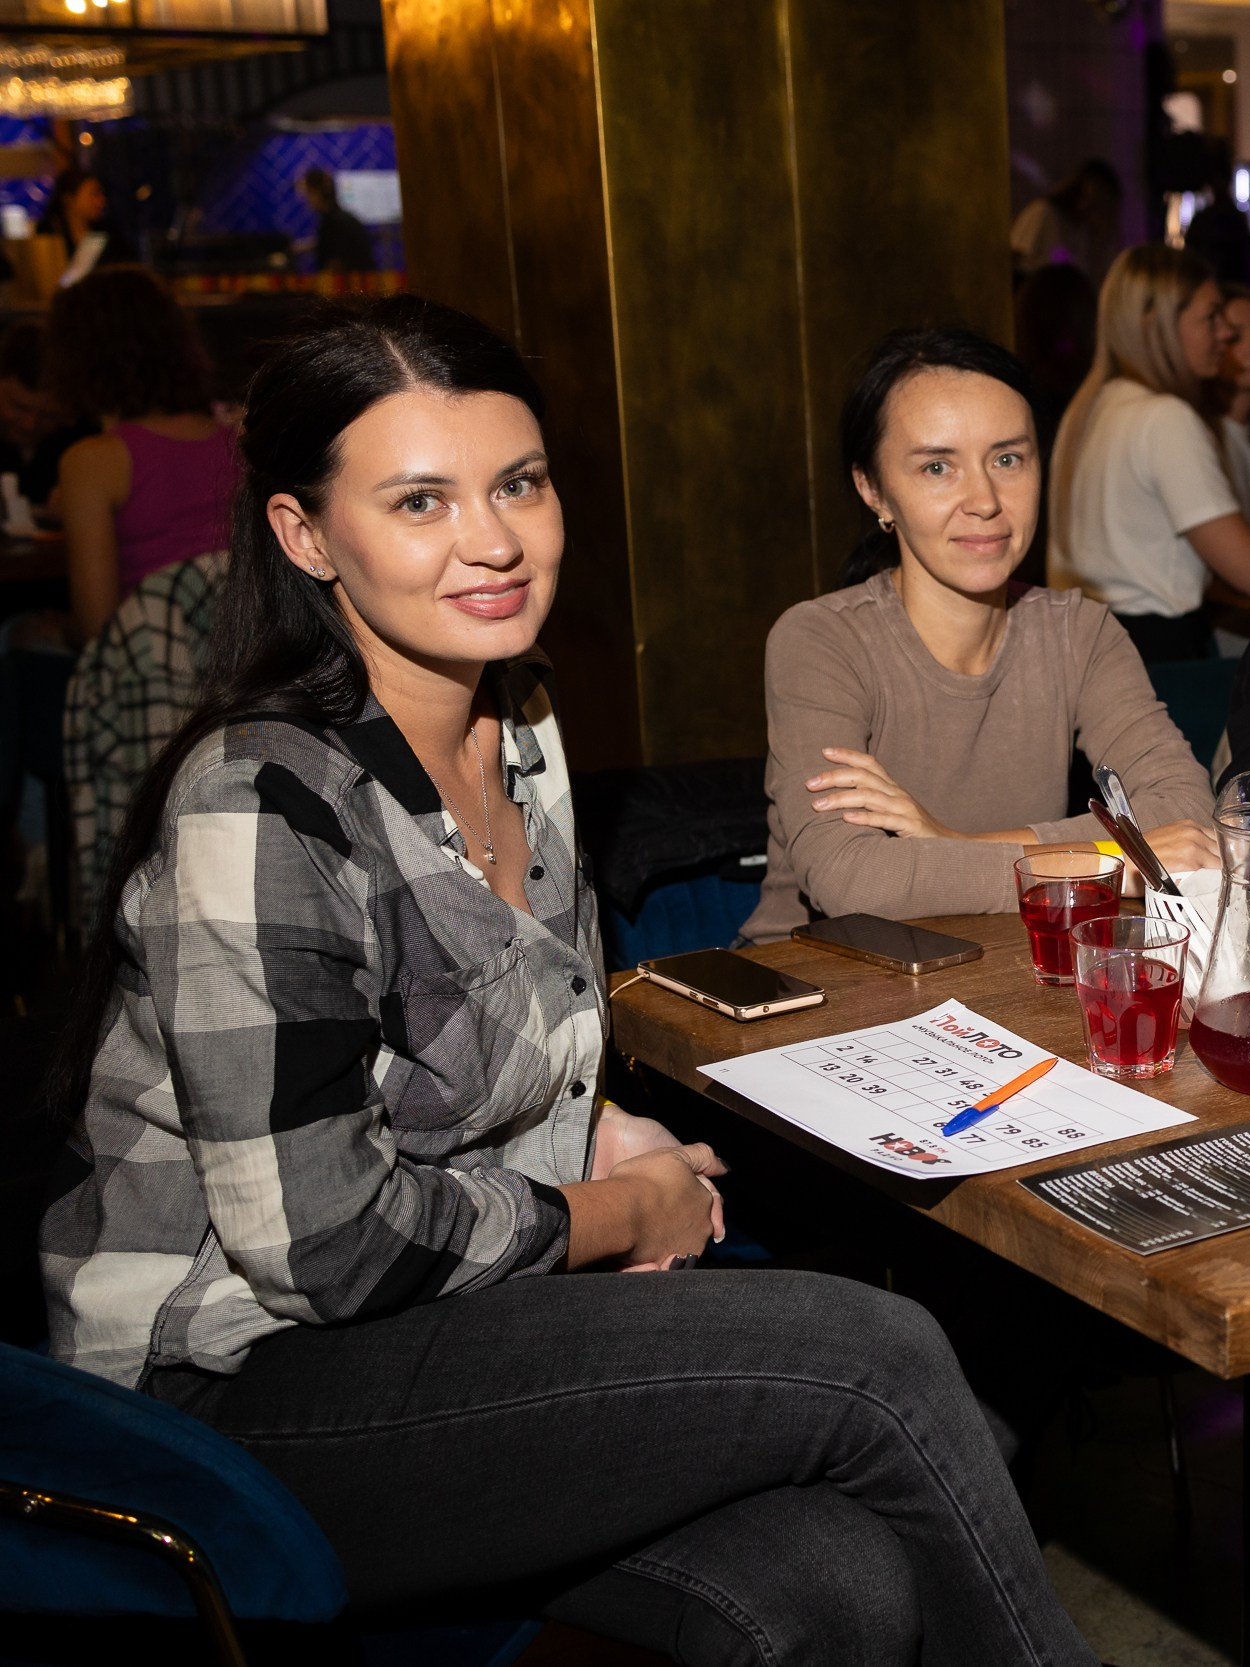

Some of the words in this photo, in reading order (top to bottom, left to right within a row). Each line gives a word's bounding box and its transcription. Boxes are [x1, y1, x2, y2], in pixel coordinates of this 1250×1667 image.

[856, 1055, 878, 1064] 14
[911, 1057, 938, 1066] 27
[818, 1062, 841, 1072] 13
[935, 1068, 959, 1077] 31
[838, 1073, 864, 1084] 20
[862, 1084, 888, 1095] 39
[960, 1080, 984, 1090] 48
[932, 1122, 948, 1130] 6
[995, 1124, 1022, 1135] 79
[1058, 1128, 1086, 1138] 88
[959, 1133, 987, 1144] 77
[1021, 1138, 1049, 1148] 85
